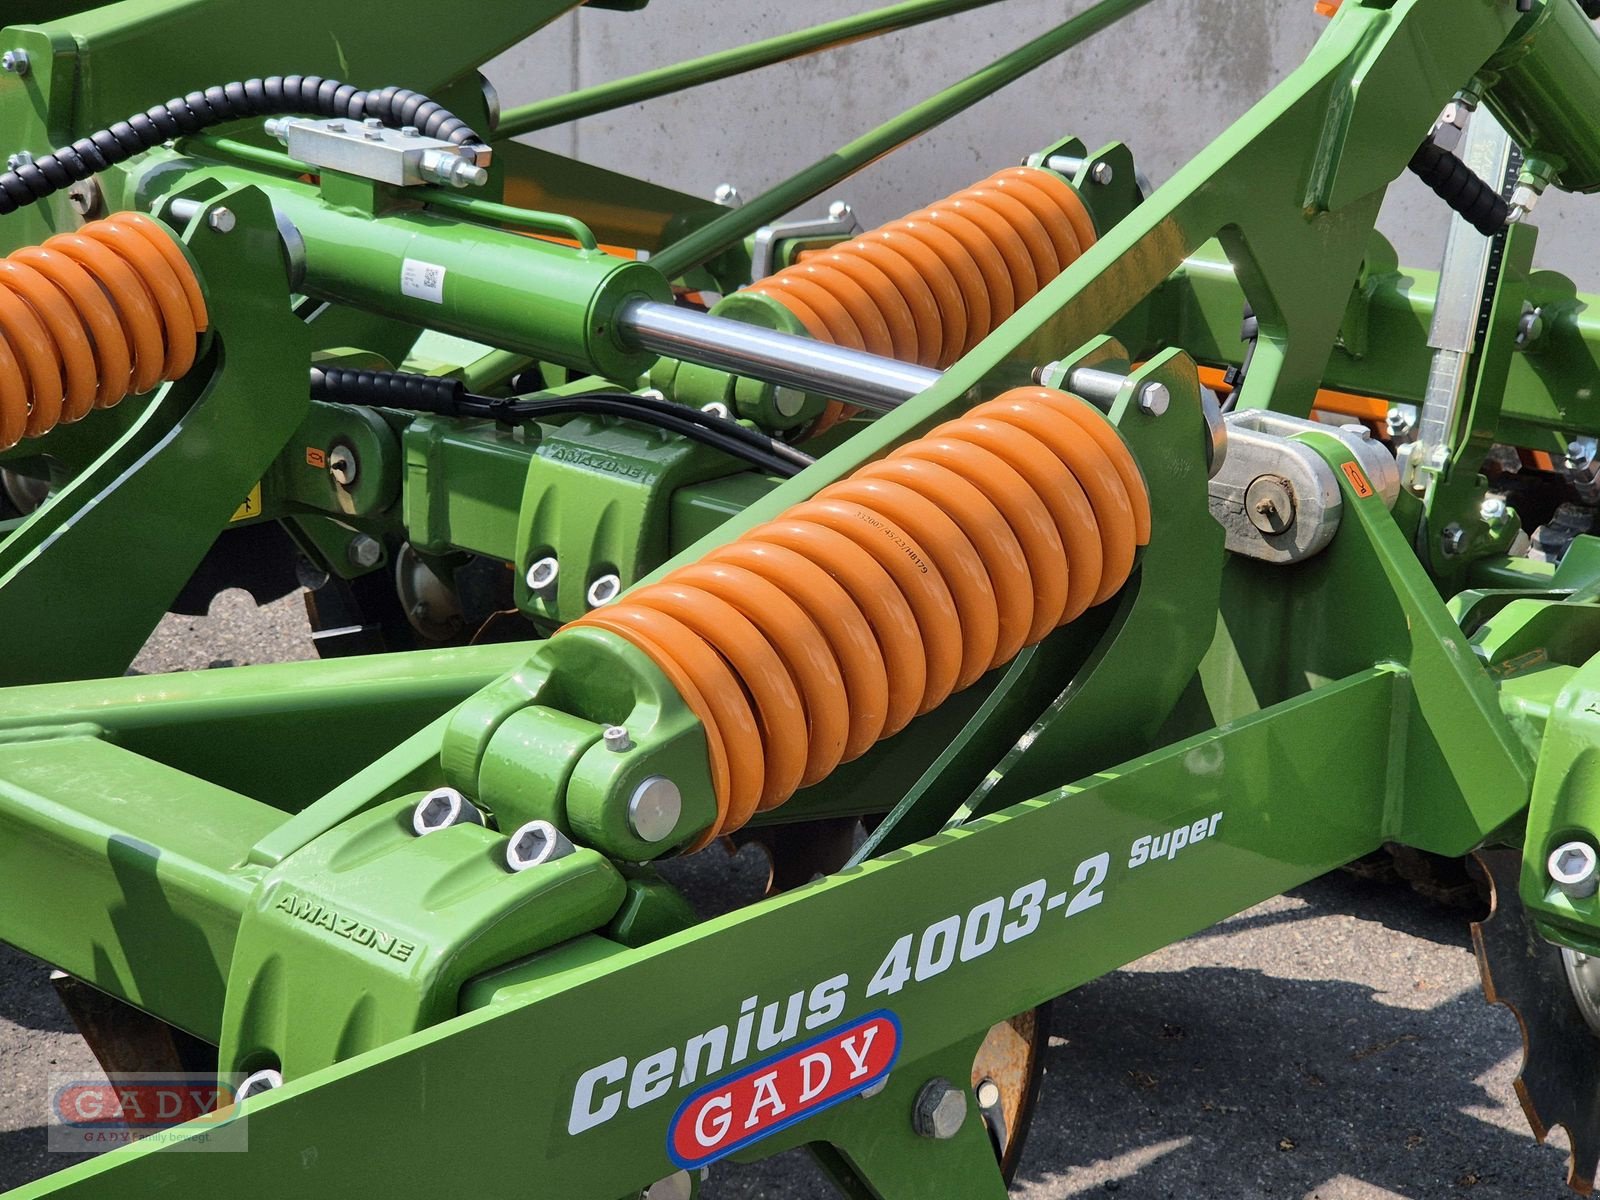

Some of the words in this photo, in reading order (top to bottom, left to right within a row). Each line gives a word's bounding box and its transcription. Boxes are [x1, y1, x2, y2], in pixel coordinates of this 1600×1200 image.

[551, 447, 642, 479] AMAZONE
[276, 895, 415, 963] AMAZONE
[567, 973, 849, 1136] Cenius
[865, 852, 1110, 999] 4003-2
[1127, 812, 1223, 868] Super
[694, 1026, 879, 1147] GADY
